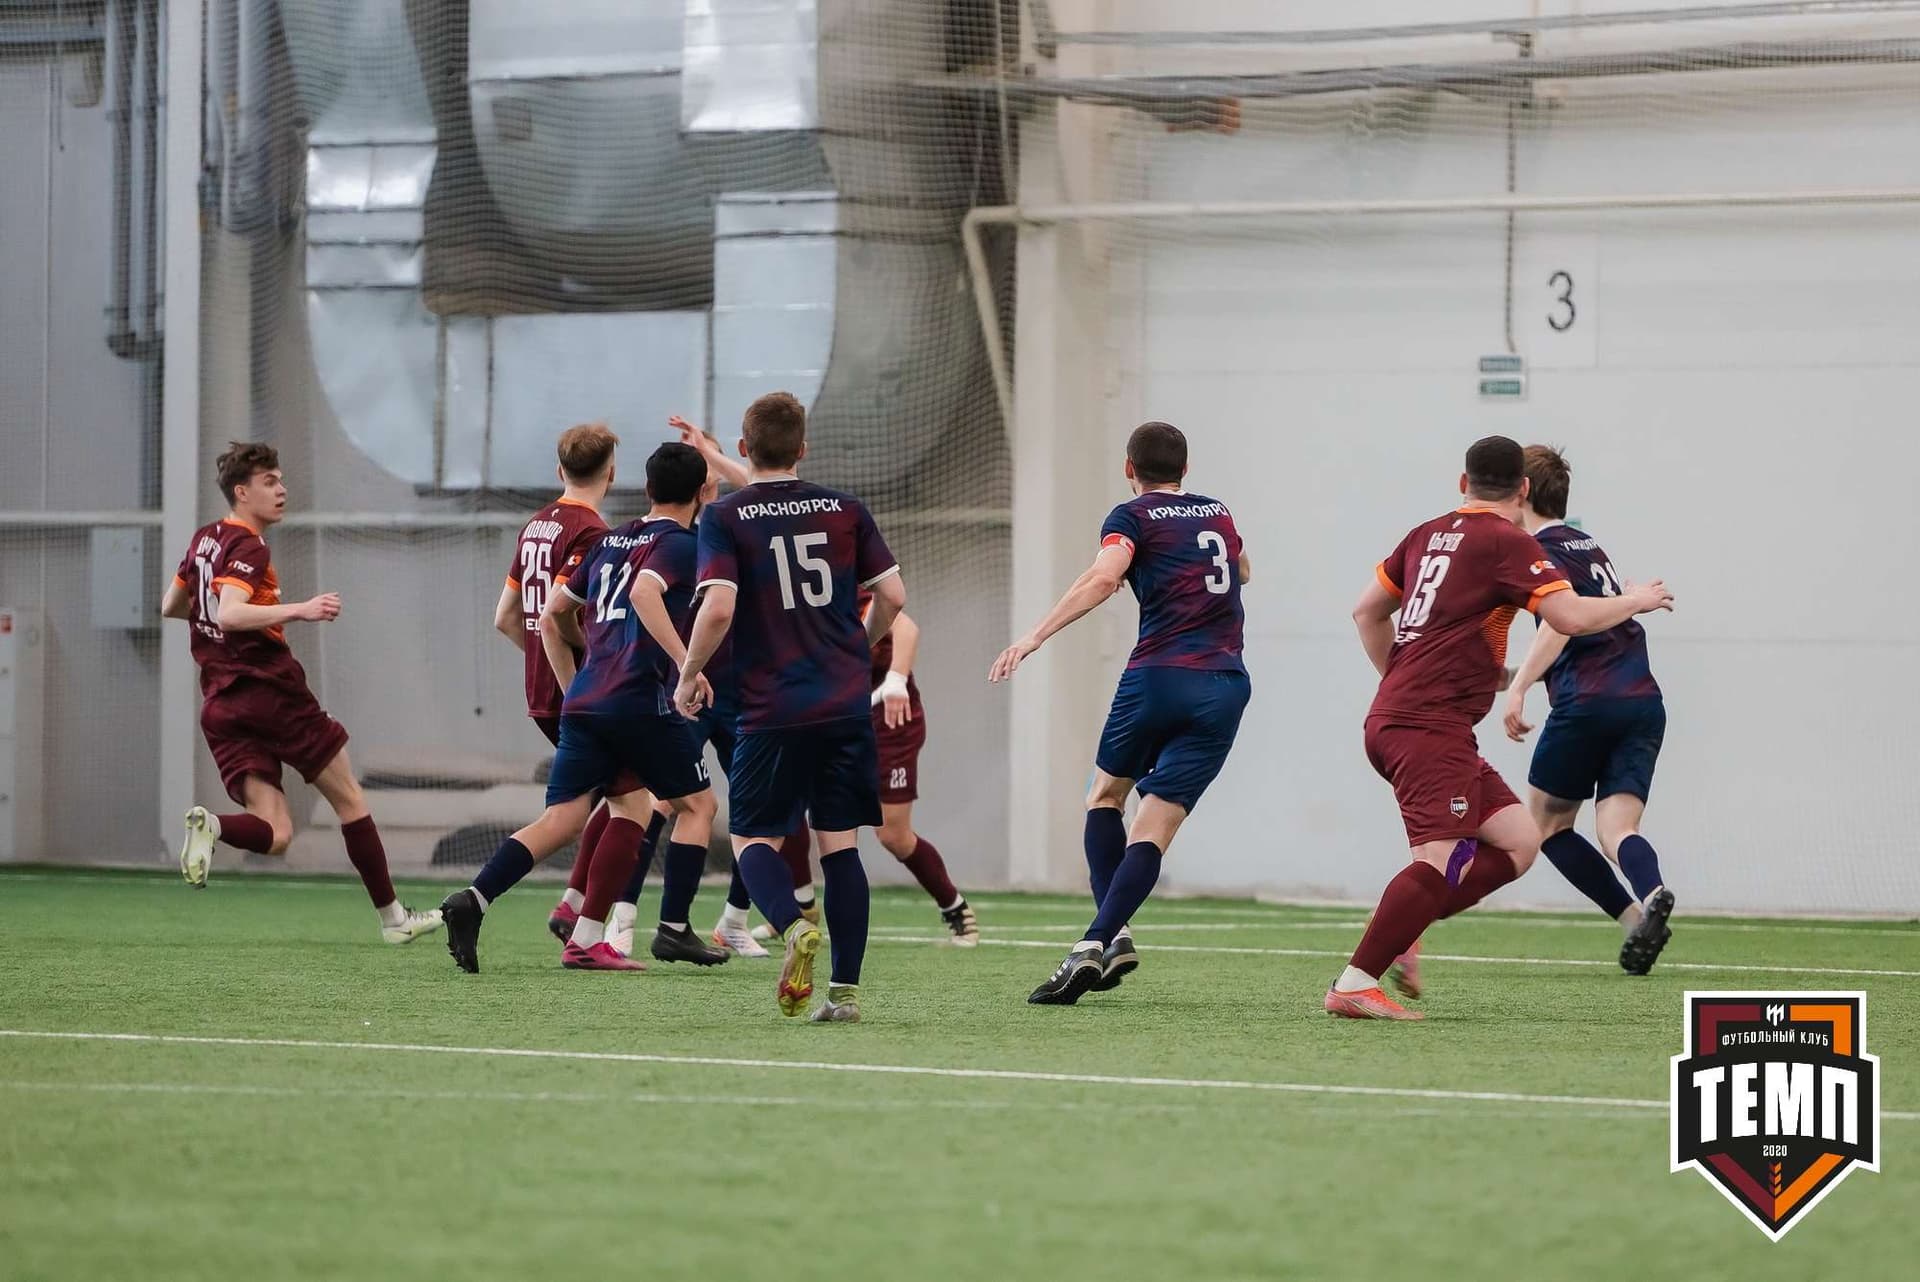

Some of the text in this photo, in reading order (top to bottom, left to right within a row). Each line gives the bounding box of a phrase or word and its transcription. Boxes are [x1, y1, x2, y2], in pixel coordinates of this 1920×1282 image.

[1548, 270, 1575, 332] 3
[737, 498, 842, 520] КРАСНОЯРСК
[1147, 503, 1230, 520] КРАСНОЯРС
[521, 541, 552, 614] 25
[596, 561, 632, 623] 12
[769, 532, 833, 610] 15
[1197, 531, 1231, 594] 3
[1400, 555, 1451, 628] 13
[694, 757, 709, 783] 12
[890, 767, 907, 788] 22
